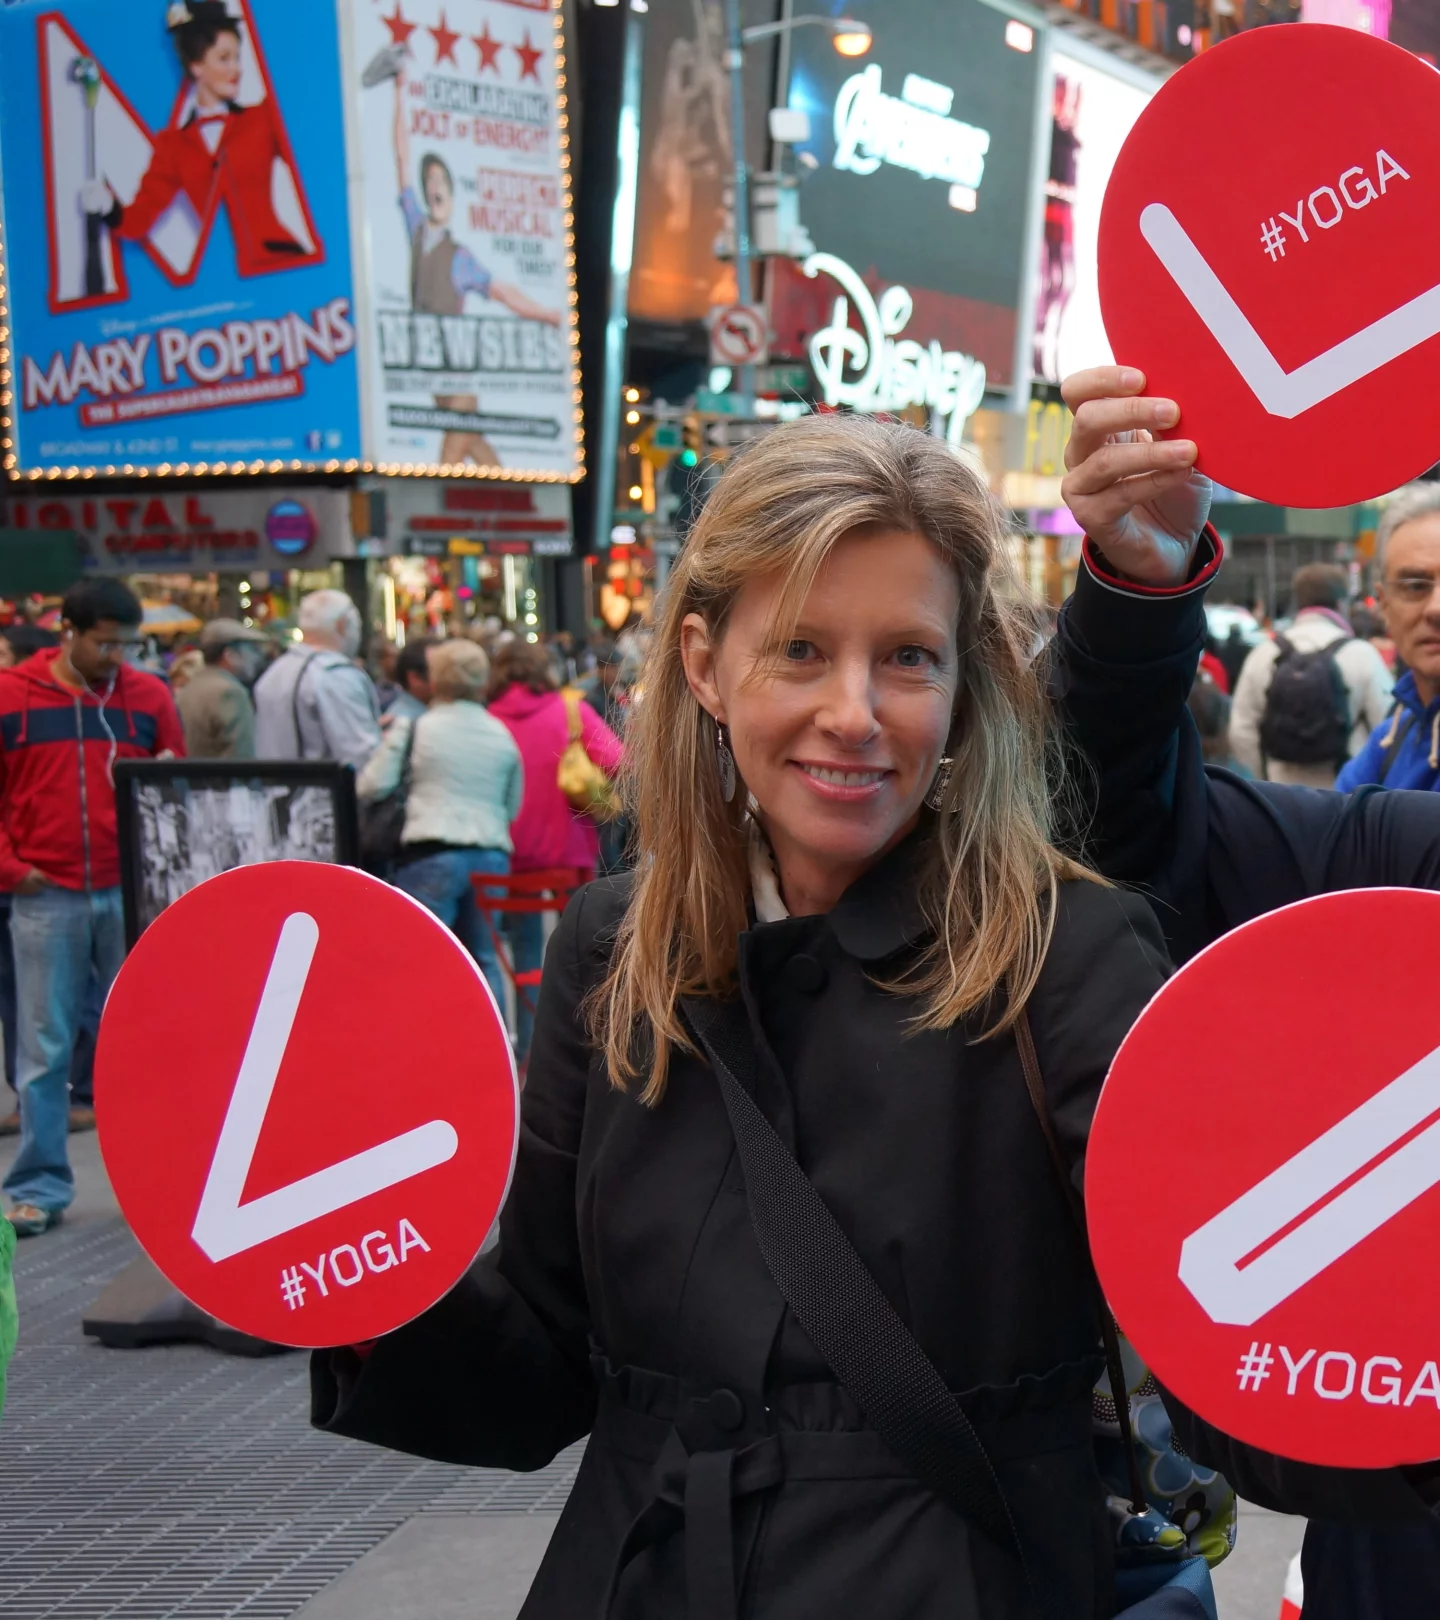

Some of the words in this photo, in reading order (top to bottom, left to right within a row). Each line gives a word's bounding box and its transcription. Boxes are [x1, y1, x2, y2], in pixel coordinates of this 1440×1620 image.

[1260, 149, 1411, 262] #YOGA
[23, 333, 151, 409] MARY
[158, 297, 356, 385] POPPINS
[379, 314, 564, 371] NEWSIES
[13, 496, 213, 529] IGITAL
[280, 1218, 431, 1310] #YOGA
